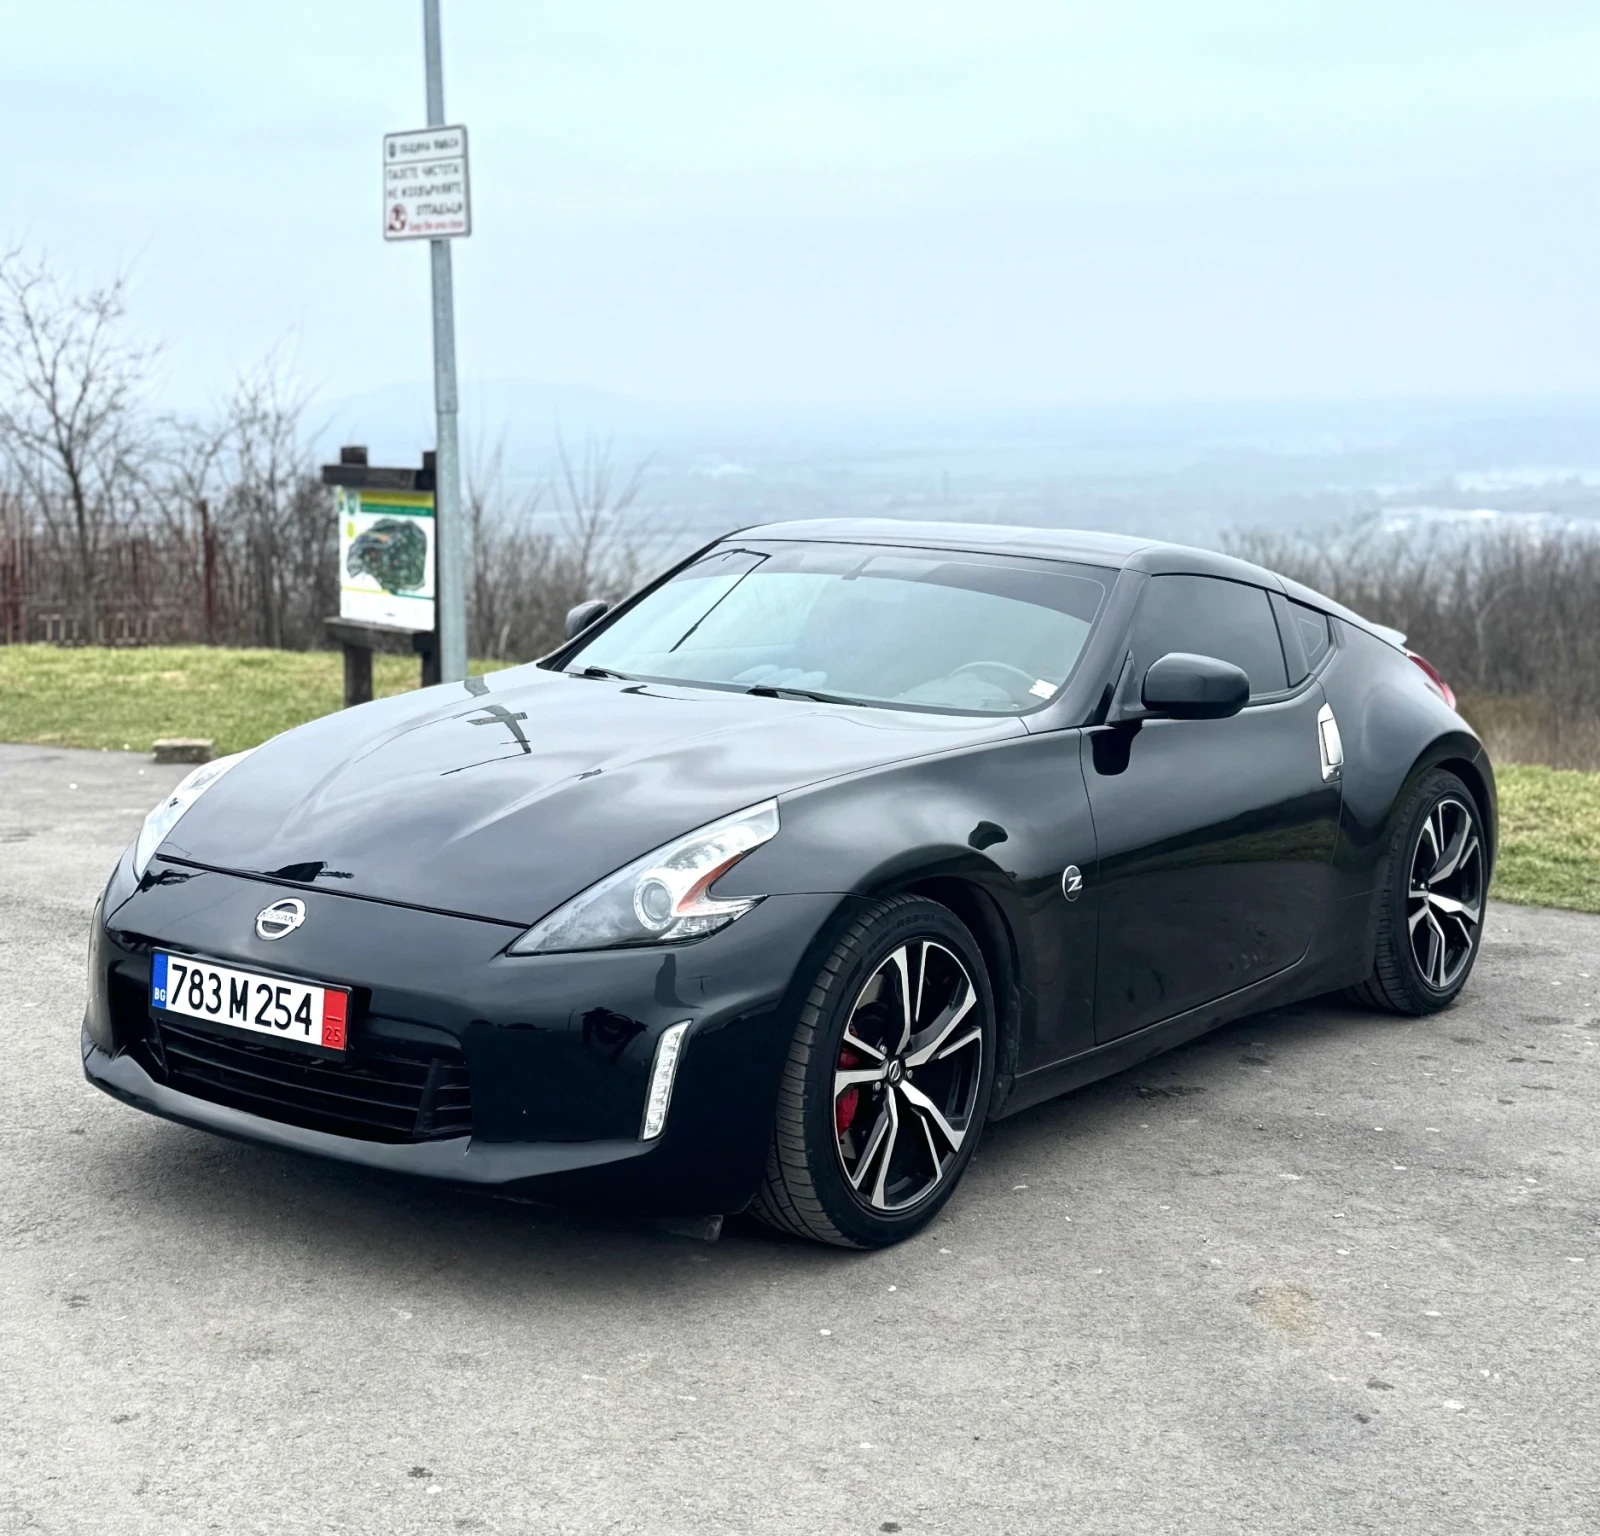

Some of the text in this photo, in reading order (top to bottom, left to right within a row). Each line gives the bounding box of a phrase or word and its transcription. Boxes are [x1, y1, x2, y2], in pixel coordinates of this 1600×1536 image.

[259, 910, 297, 924] NISSAN
[153, 987, 166, 1001] BG
[171, 963, 313, 1036] 783 M 254
[325, 1027, 341, 1042] 25
